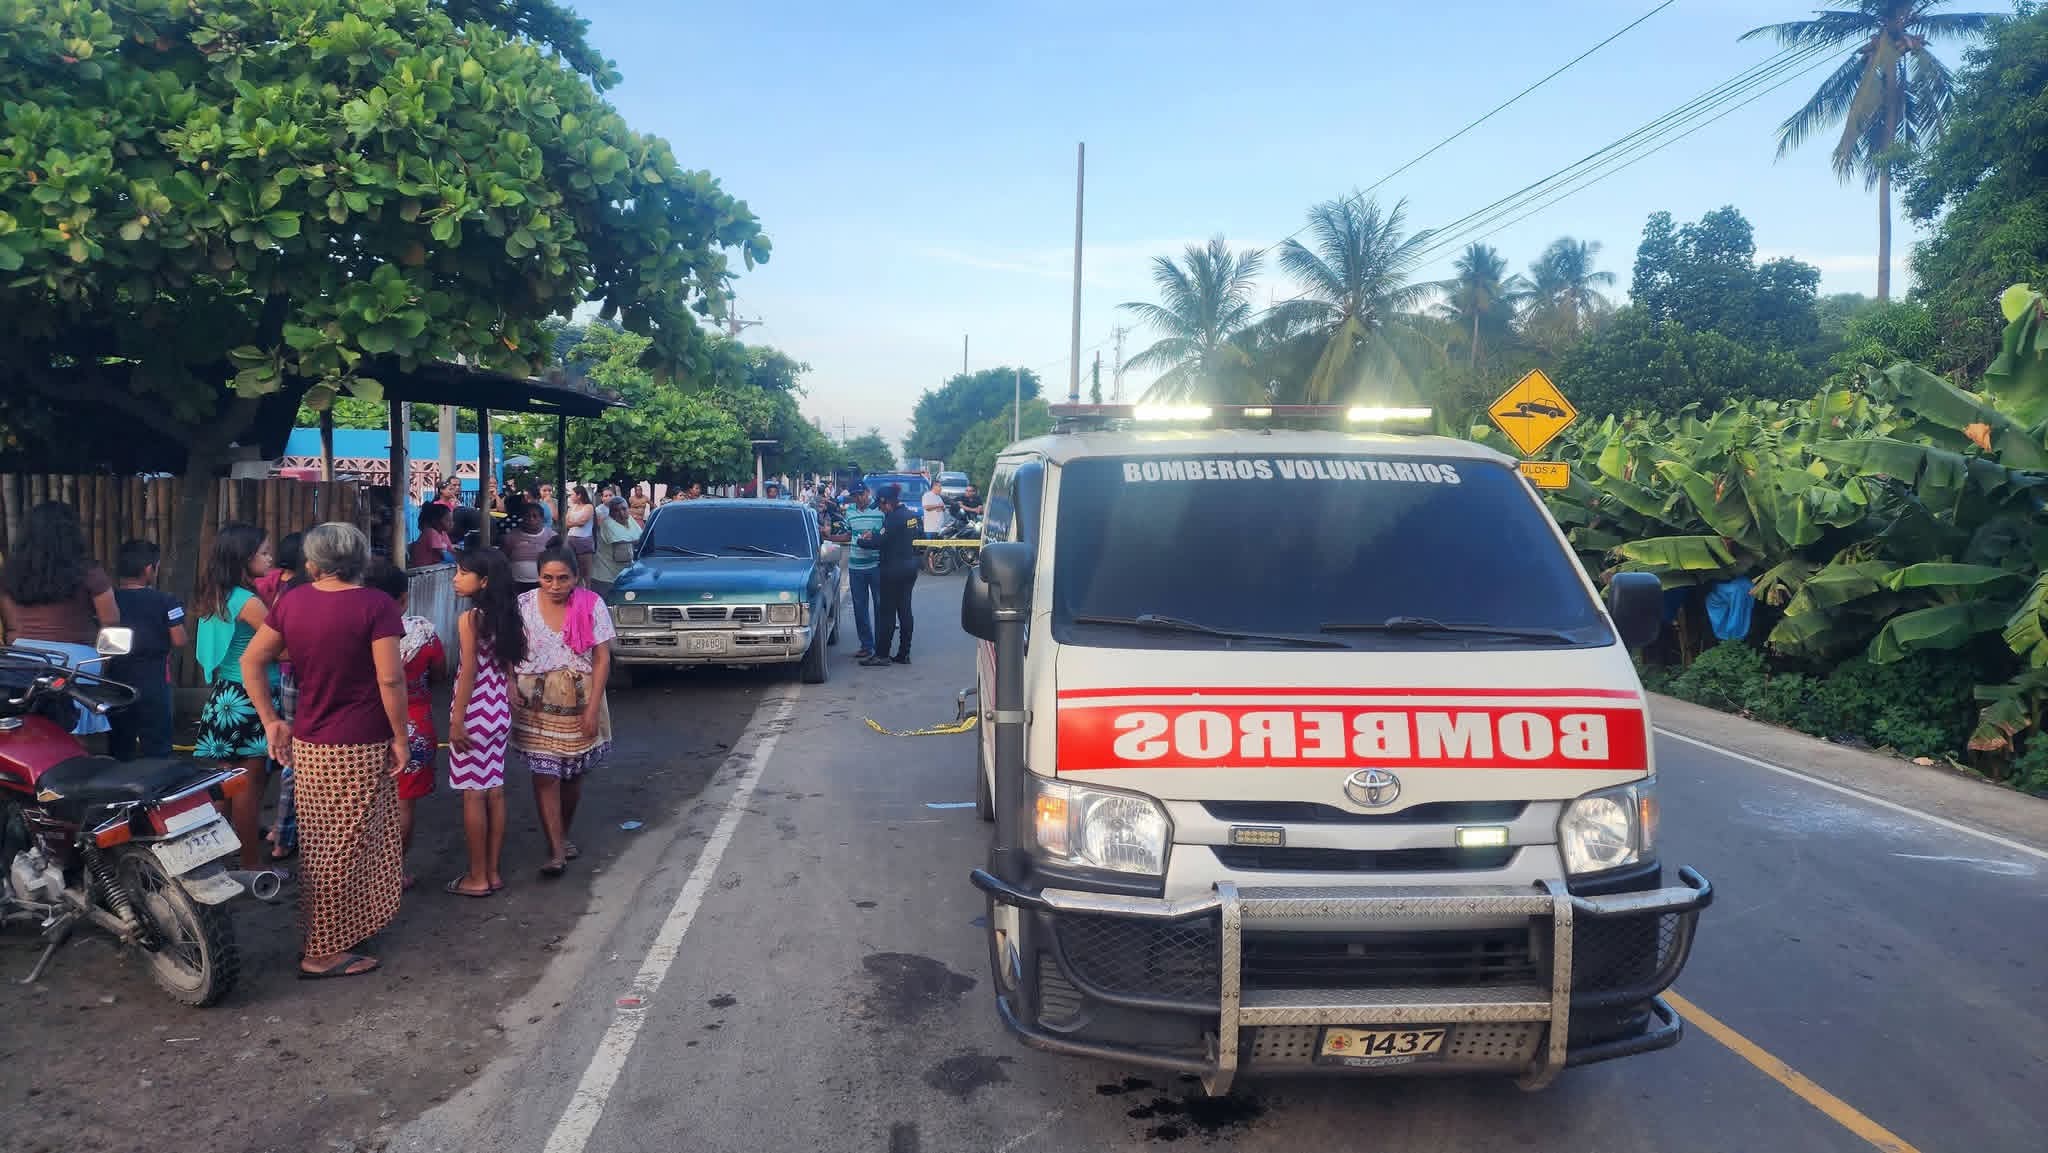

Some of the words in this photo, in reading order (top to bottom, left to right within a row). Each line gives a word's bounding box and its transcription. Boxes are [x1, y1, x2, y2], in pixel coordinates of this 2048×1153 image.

[1122, 460, 1273, 482] BOMBEROS
[1275, 459, 1461, 484] VOLUNTARIOS
[1359, 1031, 1446, 1056] 1437
